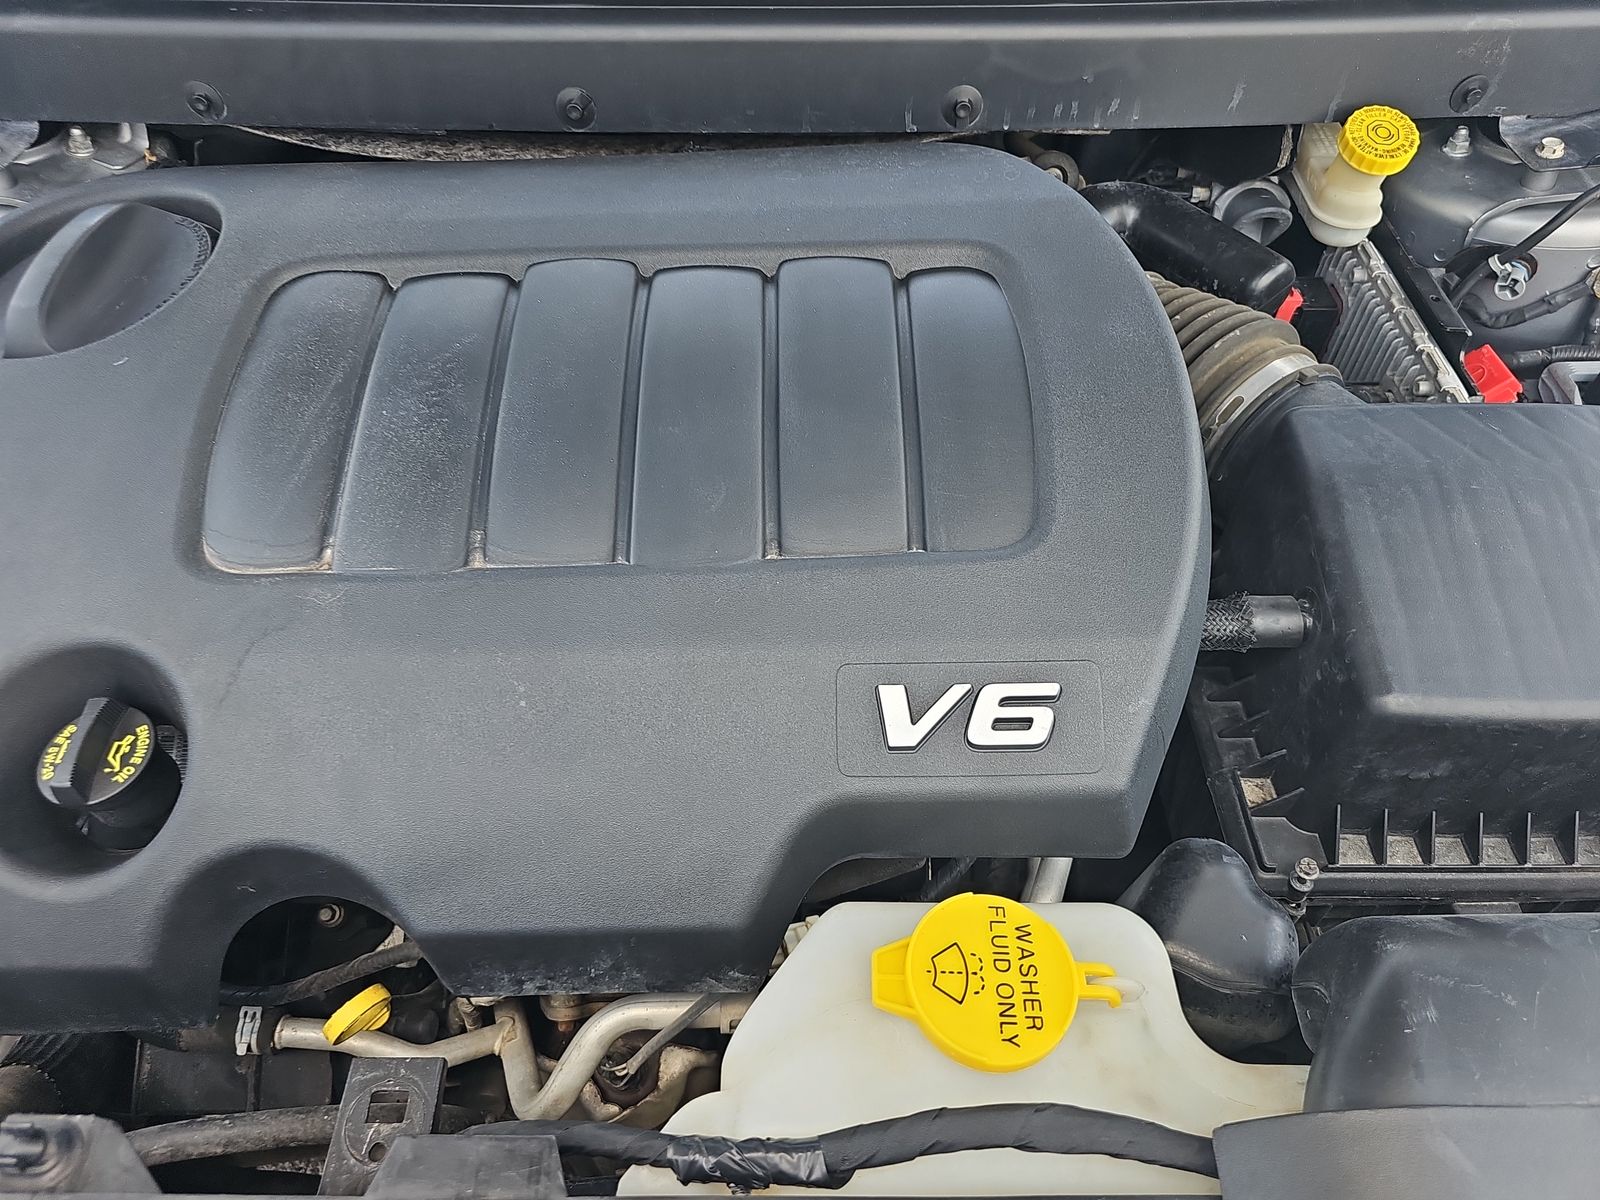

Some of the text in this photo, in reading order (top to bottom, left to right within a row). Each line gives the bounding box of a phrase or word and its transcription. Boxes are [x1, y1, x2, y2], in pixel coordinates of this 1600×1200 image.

[54, 724, 78, 745] SAE
[875, 682, 1062, 753] V6
[110, 724, 151, 783] ENGINE OIL
[988, 905, 1021, 1048] FLUID ONLY
[1014, 923, 1044, 1032] WASHER
